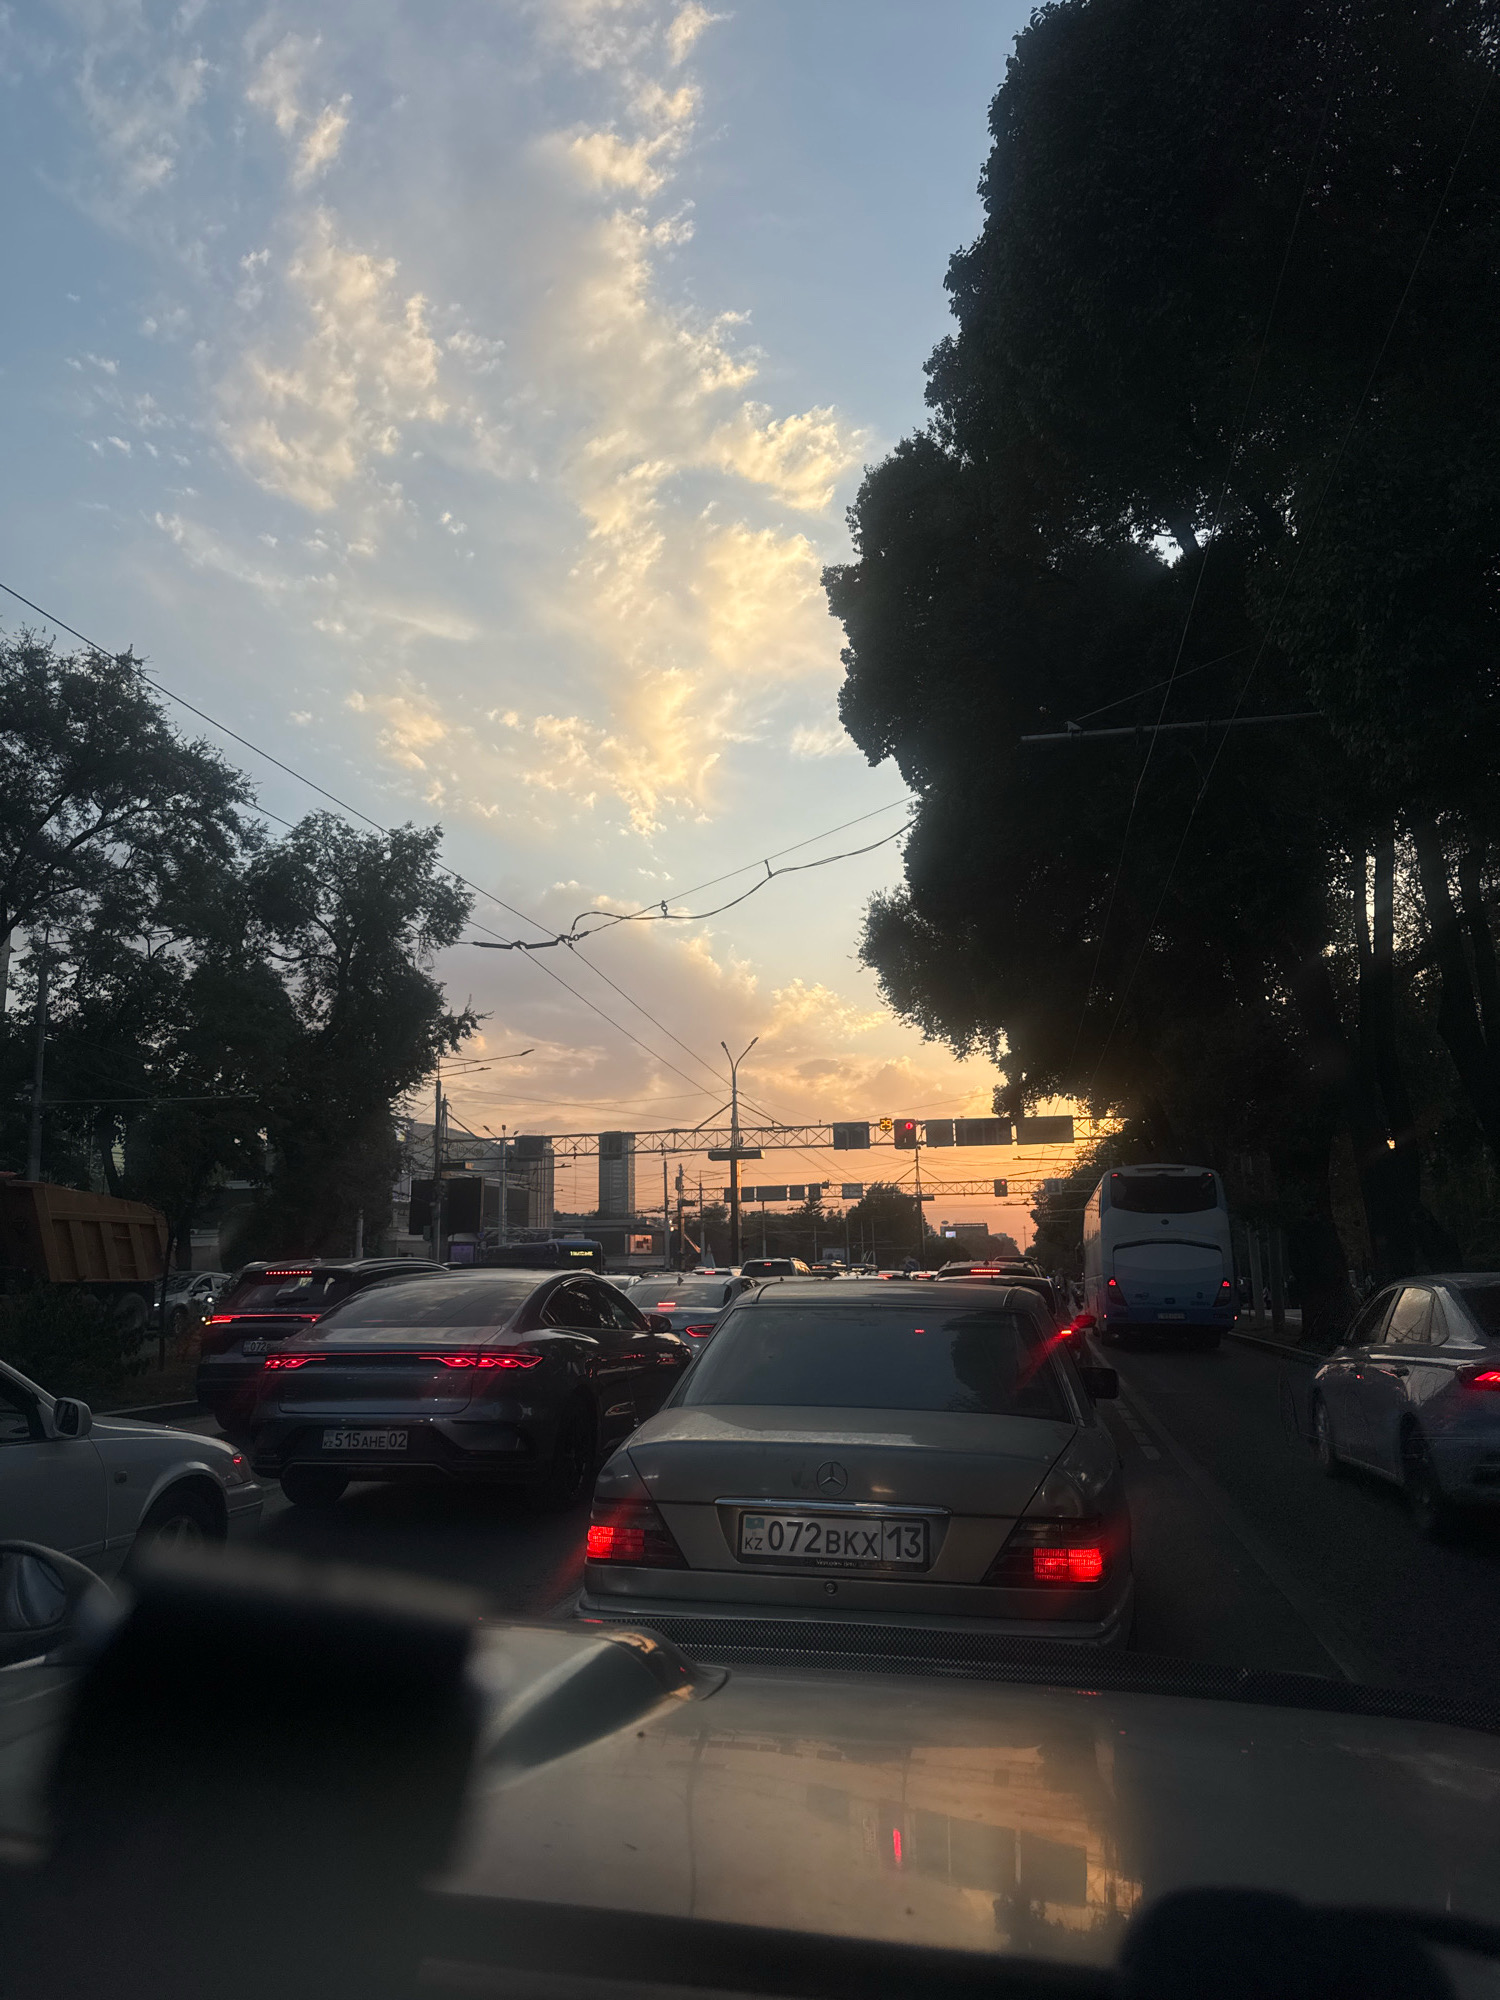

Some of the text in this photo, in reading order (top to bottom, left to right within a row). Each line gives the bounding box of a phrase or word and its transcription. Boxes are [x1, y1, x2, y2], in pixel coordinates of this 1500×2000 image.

[880, 1119, 892, 1130] 29
[389, 1432, 407, 1448] 02
[744, 1537, 763, 1551] KZ
[886, 1526, 922, 1559] 13
